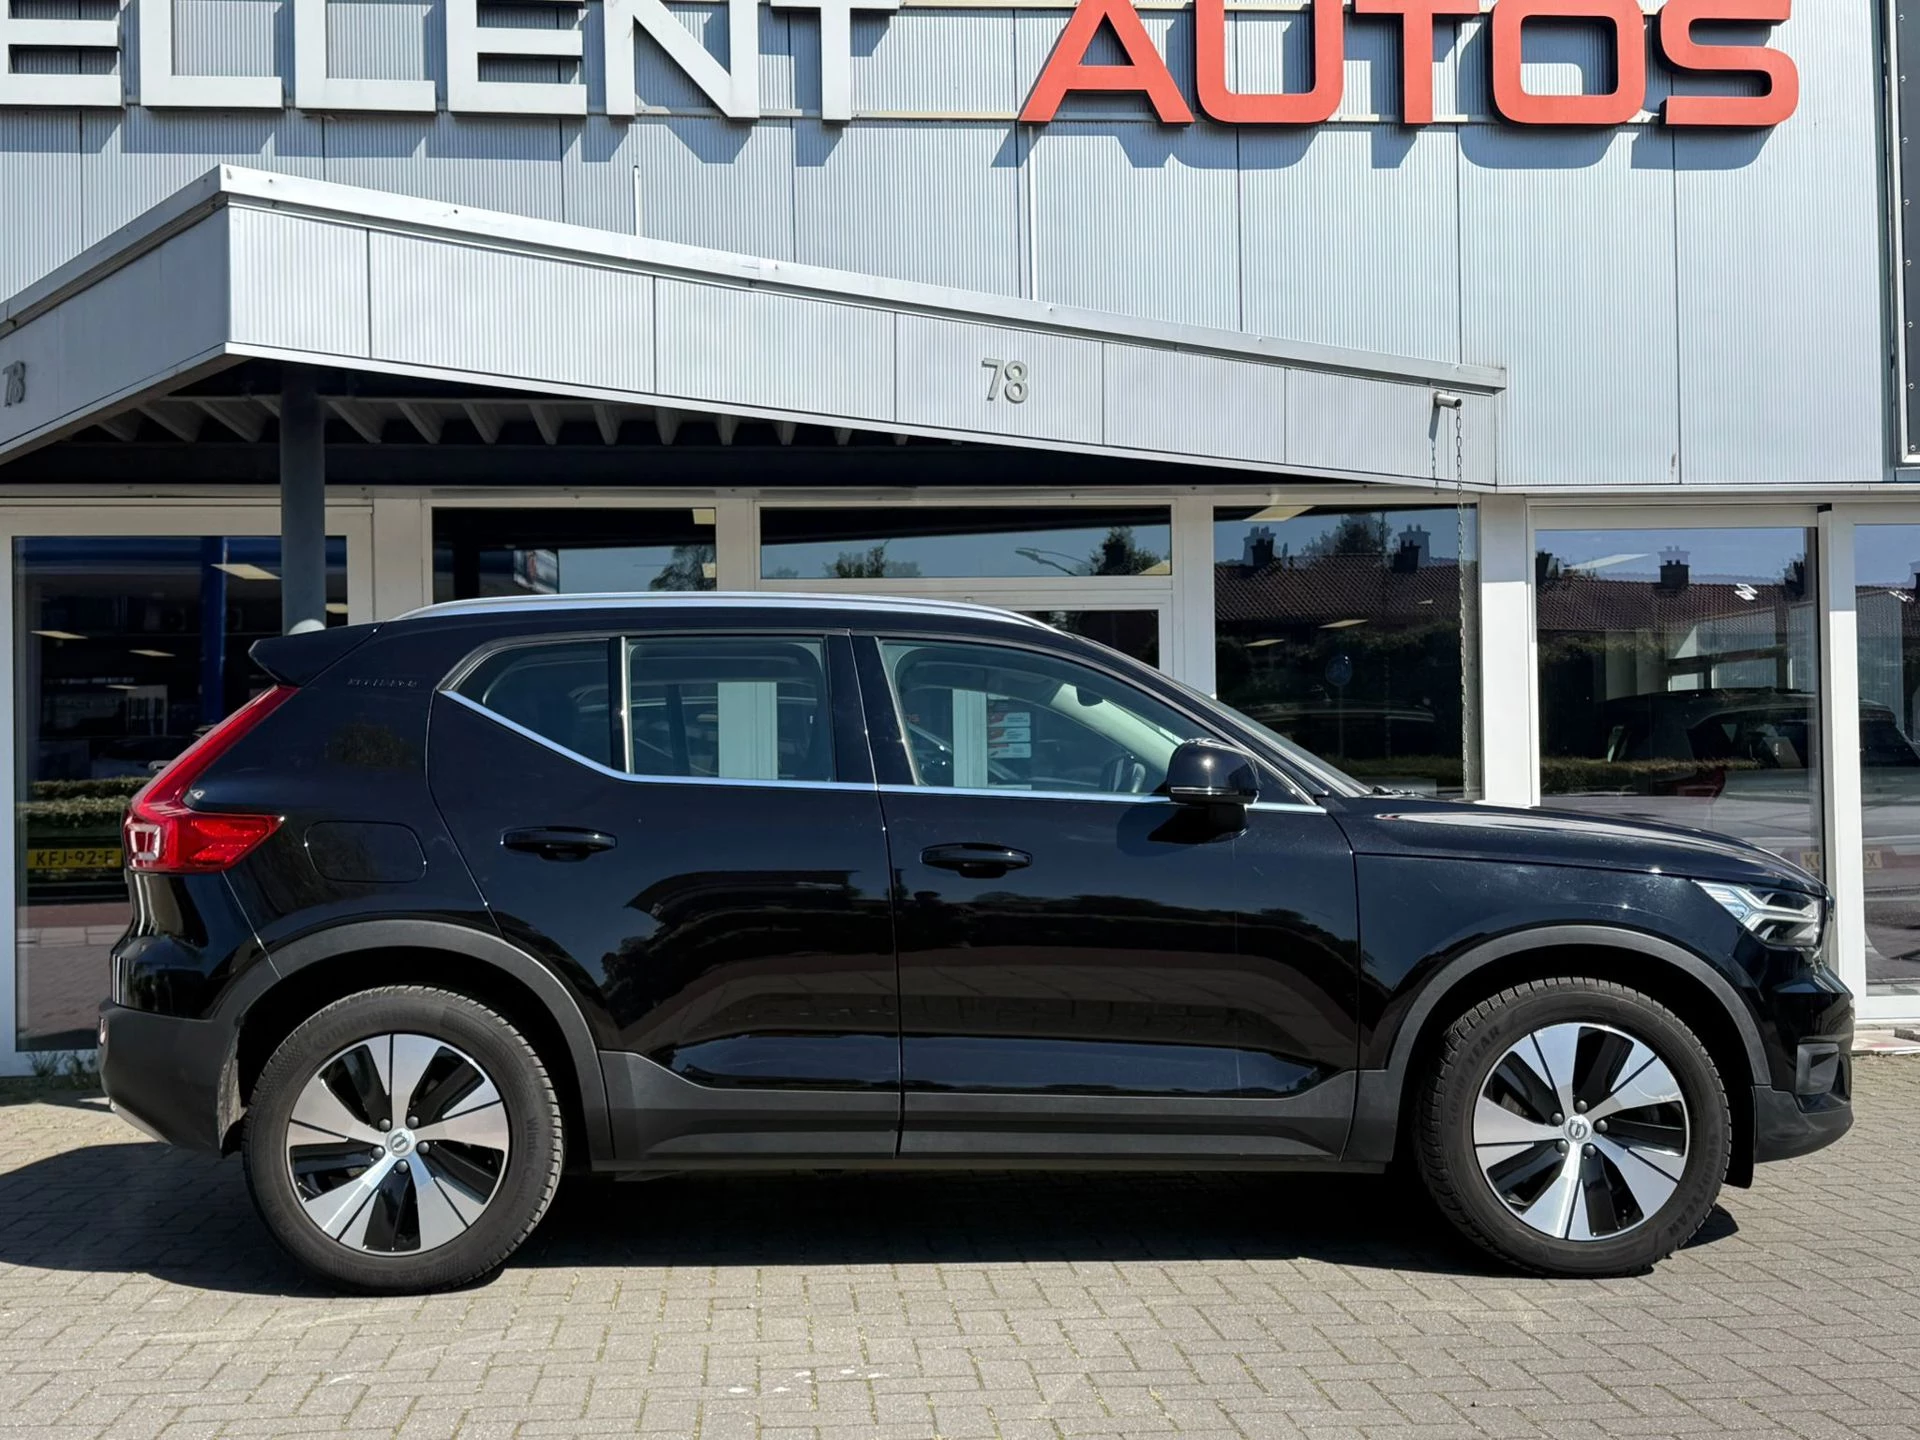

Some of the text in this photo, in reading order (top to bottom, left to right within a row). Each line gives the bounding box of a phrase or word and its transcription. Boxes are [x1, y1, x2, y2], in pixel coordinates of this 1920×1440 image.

[1019, 0, 1800, 126] AUTOS
[2, 360, 26, 407] 78
[981, 357, 1029, 404] 78
